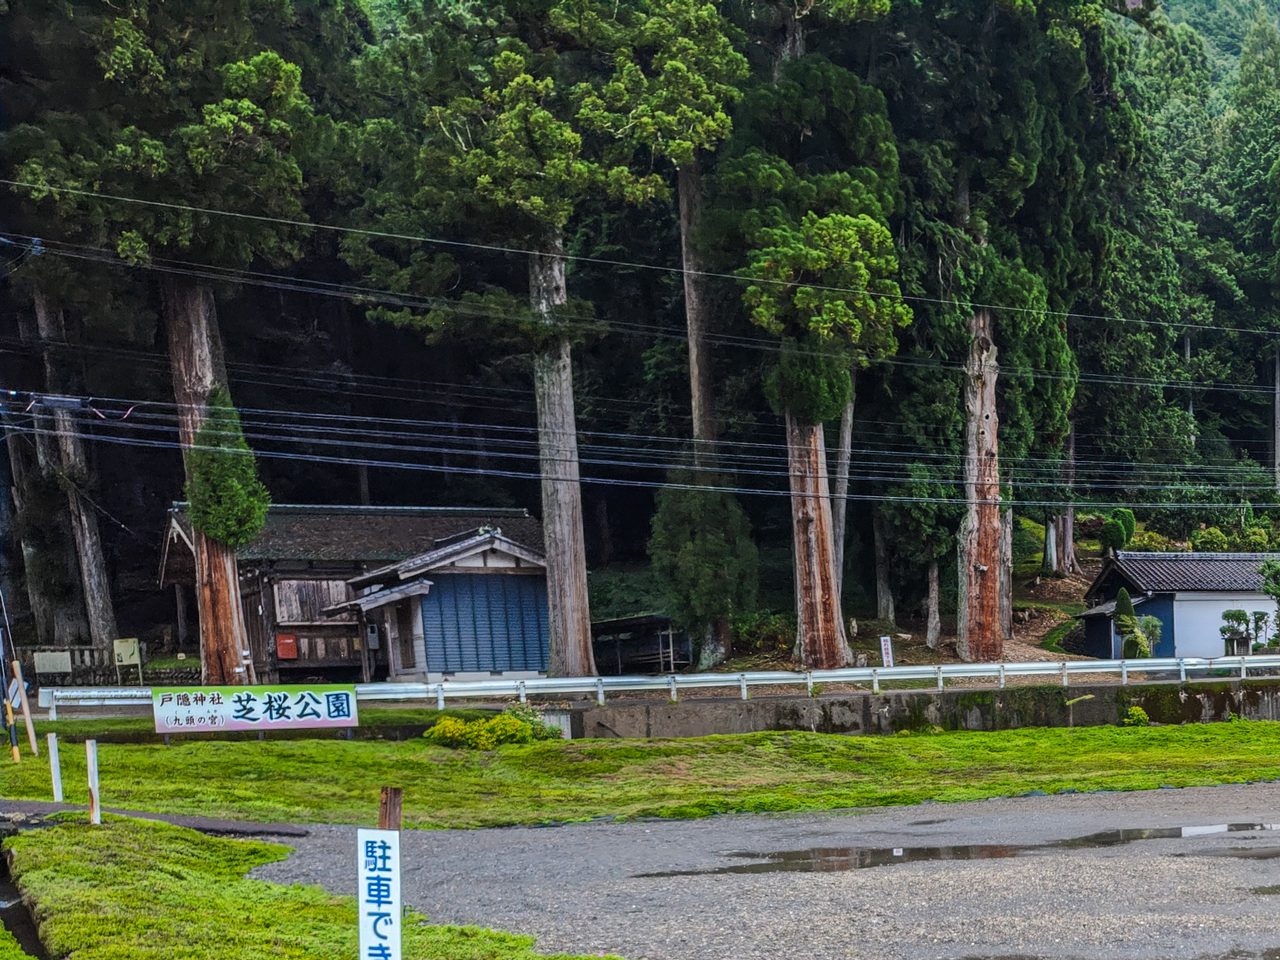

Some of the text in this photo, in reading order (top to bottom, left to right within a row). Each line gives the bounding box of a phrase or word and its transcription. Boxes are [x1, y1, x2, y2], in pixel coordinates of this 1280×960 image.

[160, 692, 223, 706] 戸隠神社
[232, 692, 350, 722] 芝桜公園
